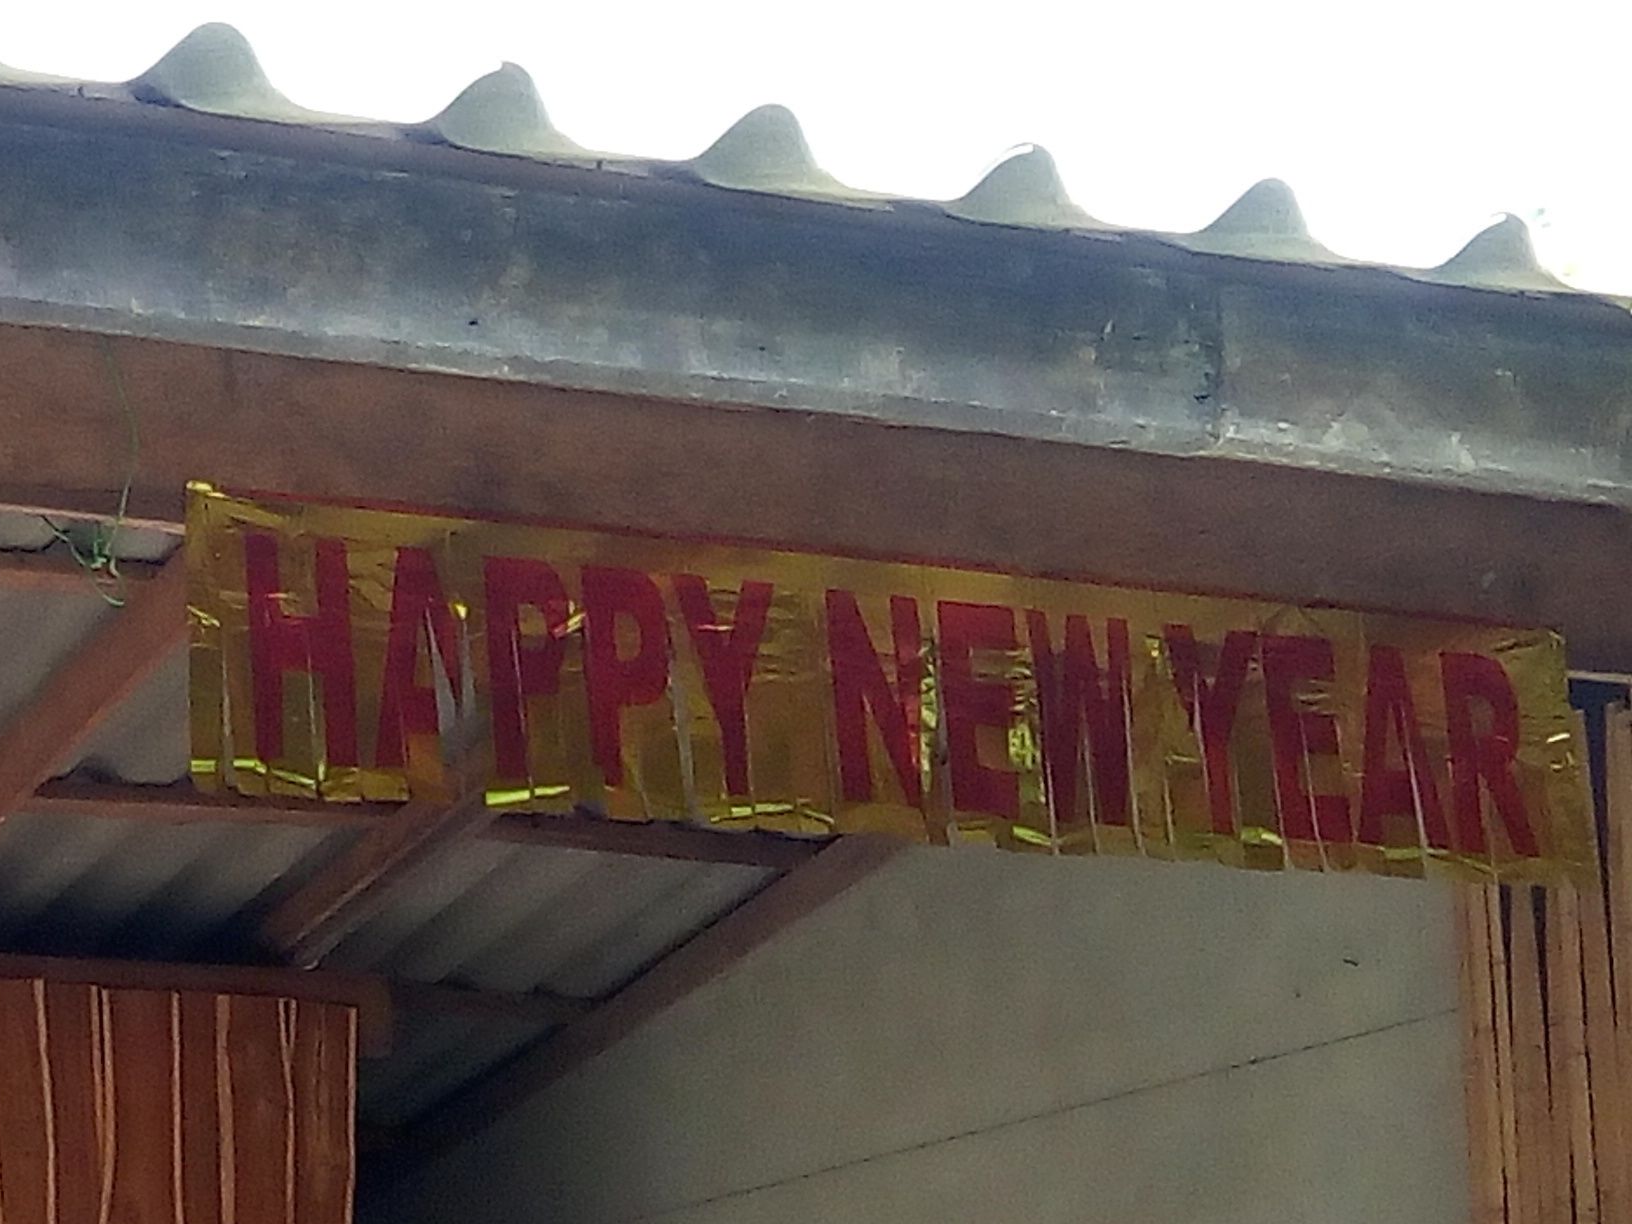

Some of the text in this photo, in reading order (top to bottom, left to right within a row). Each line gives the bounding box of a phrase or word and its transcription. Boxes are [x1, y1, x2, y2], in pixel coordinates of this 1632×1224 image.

[245, 531, 1540, 857] HAPPY NEW YEAR
